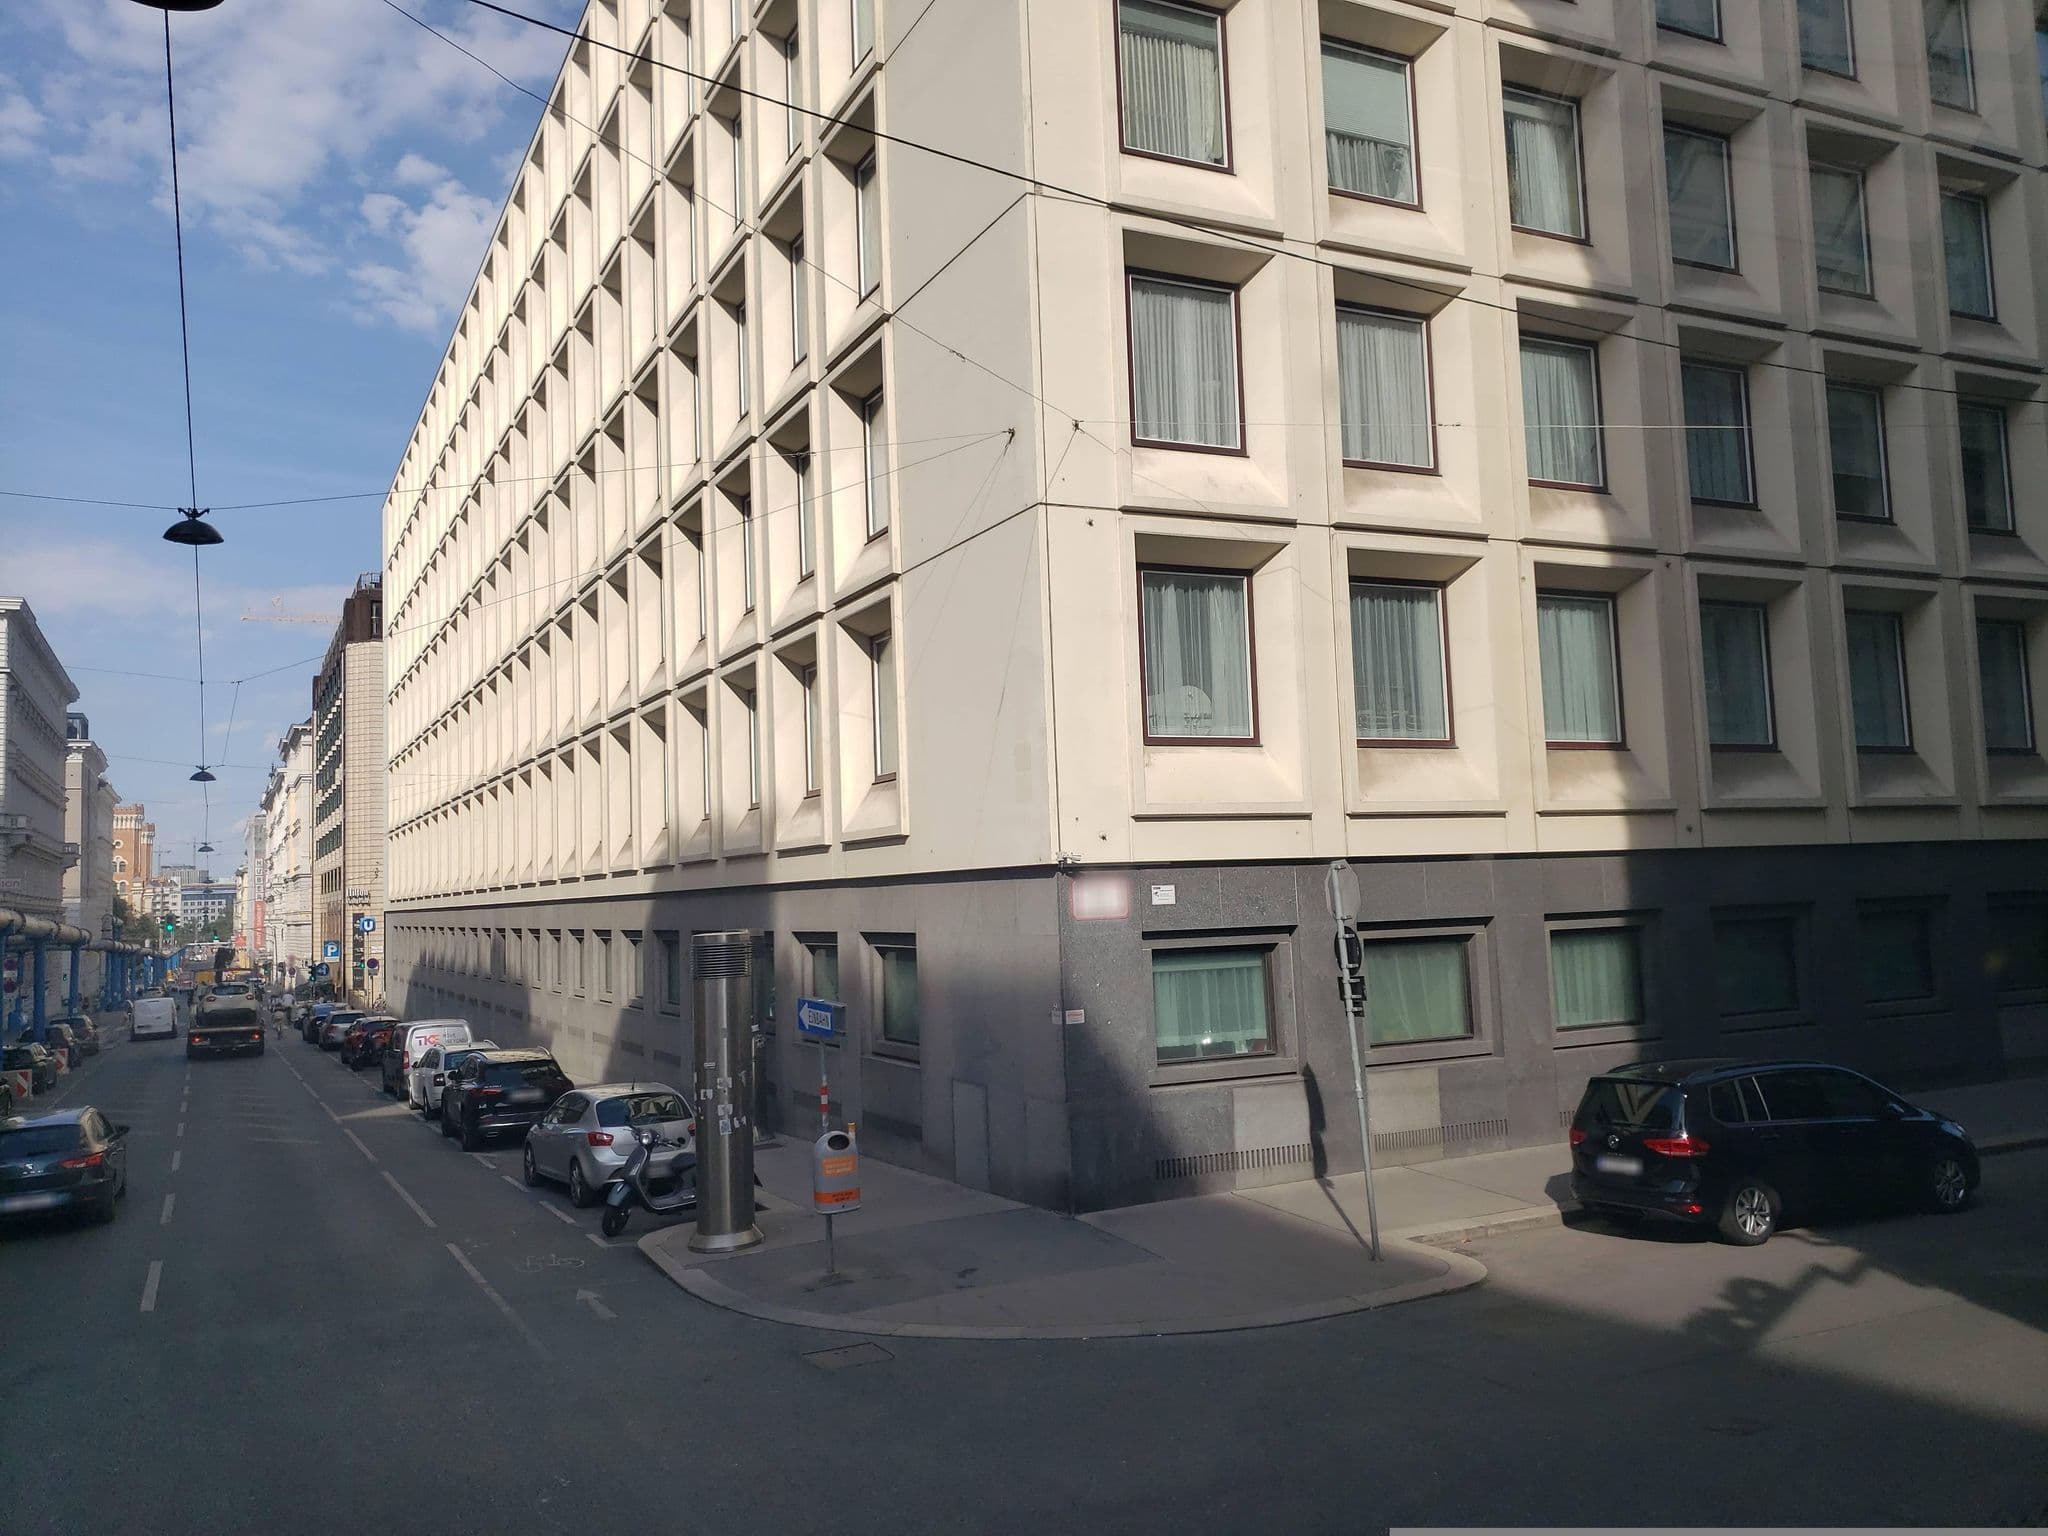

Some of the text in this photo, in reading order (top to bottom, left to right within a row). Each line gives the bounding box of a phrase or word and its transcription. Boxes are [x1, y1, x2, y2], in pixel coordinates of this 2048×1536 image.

[364, 919, 374, 931] U
[327, 944, 338, 956] P
[808, 1010, 829, 1029] EINBAHN
